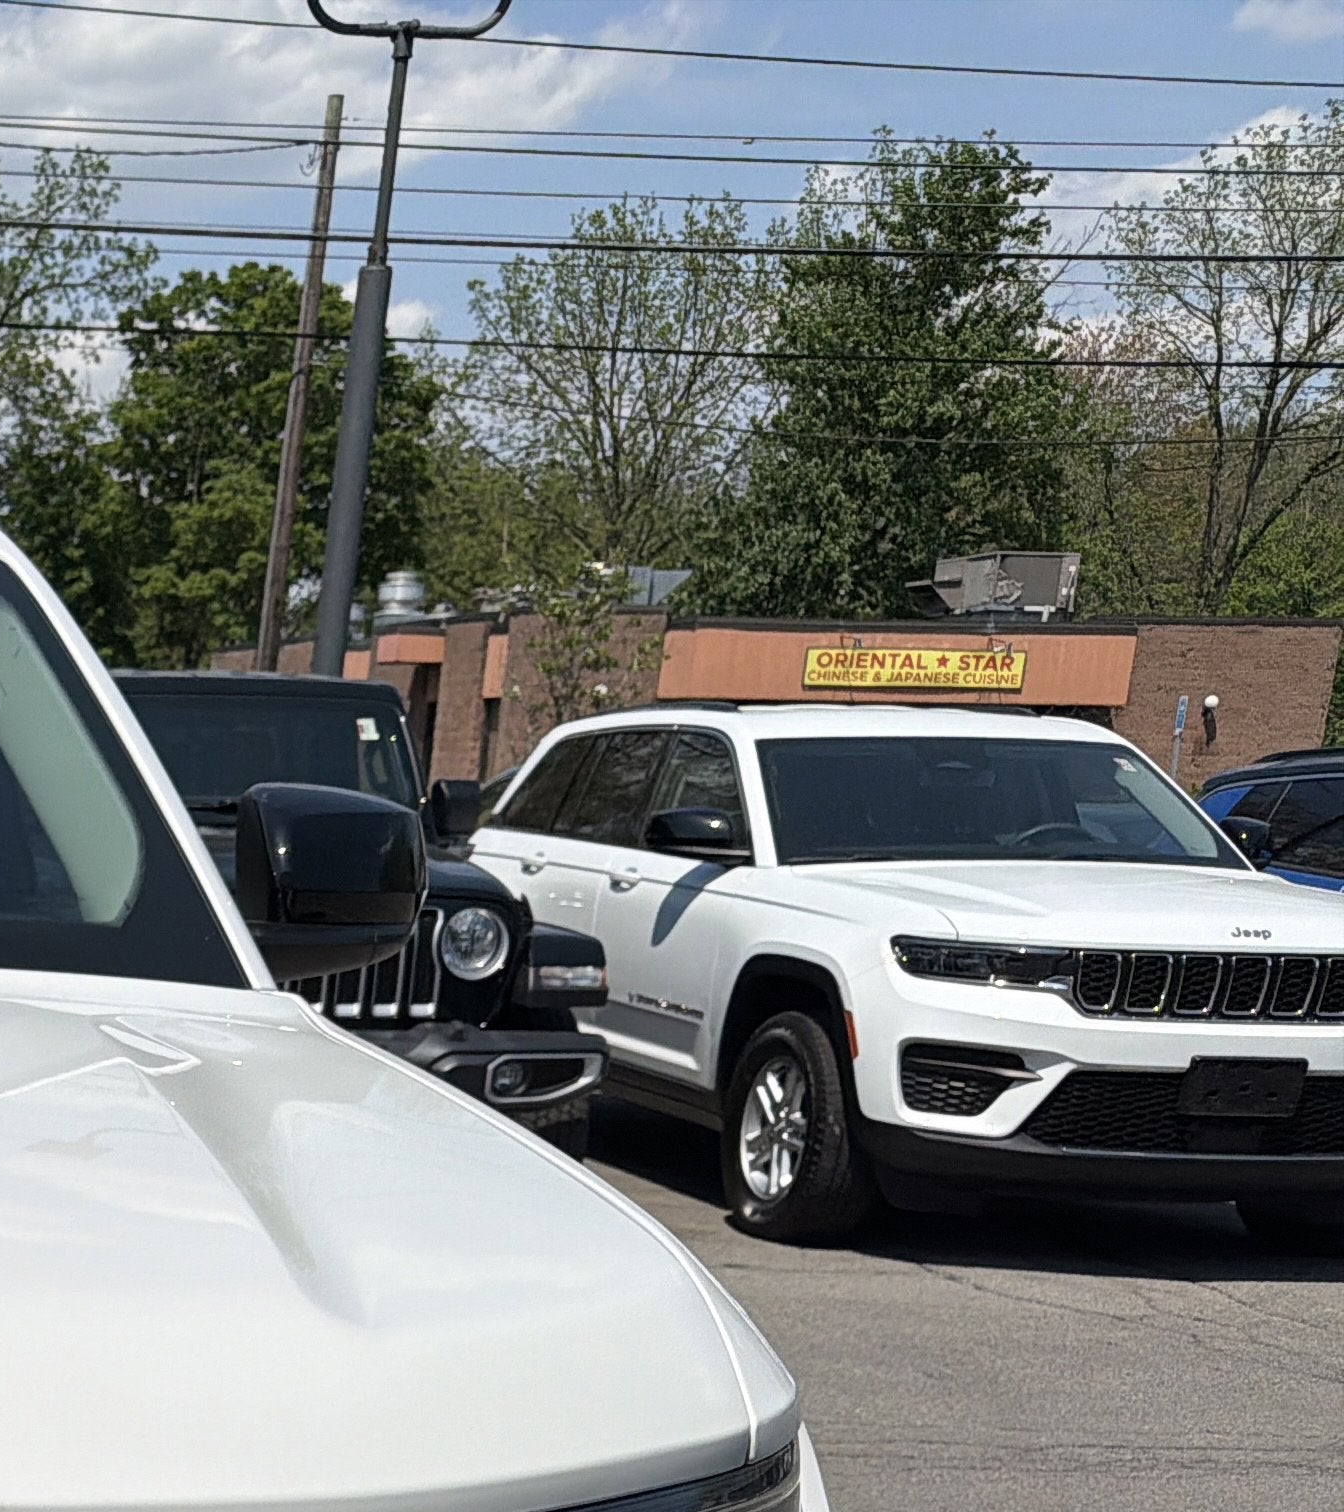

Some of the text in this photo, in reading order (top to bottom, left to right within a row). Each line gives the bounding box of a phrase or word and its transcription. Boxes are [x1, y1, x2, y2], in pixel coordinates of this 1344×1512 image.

[816, 652, 1015, 672] ORIENTAL STAR
[807, 669, 1019, 685] CHINESE & JAPANESE CUISINE
[1231, 926, 1272, 941] Jeep
